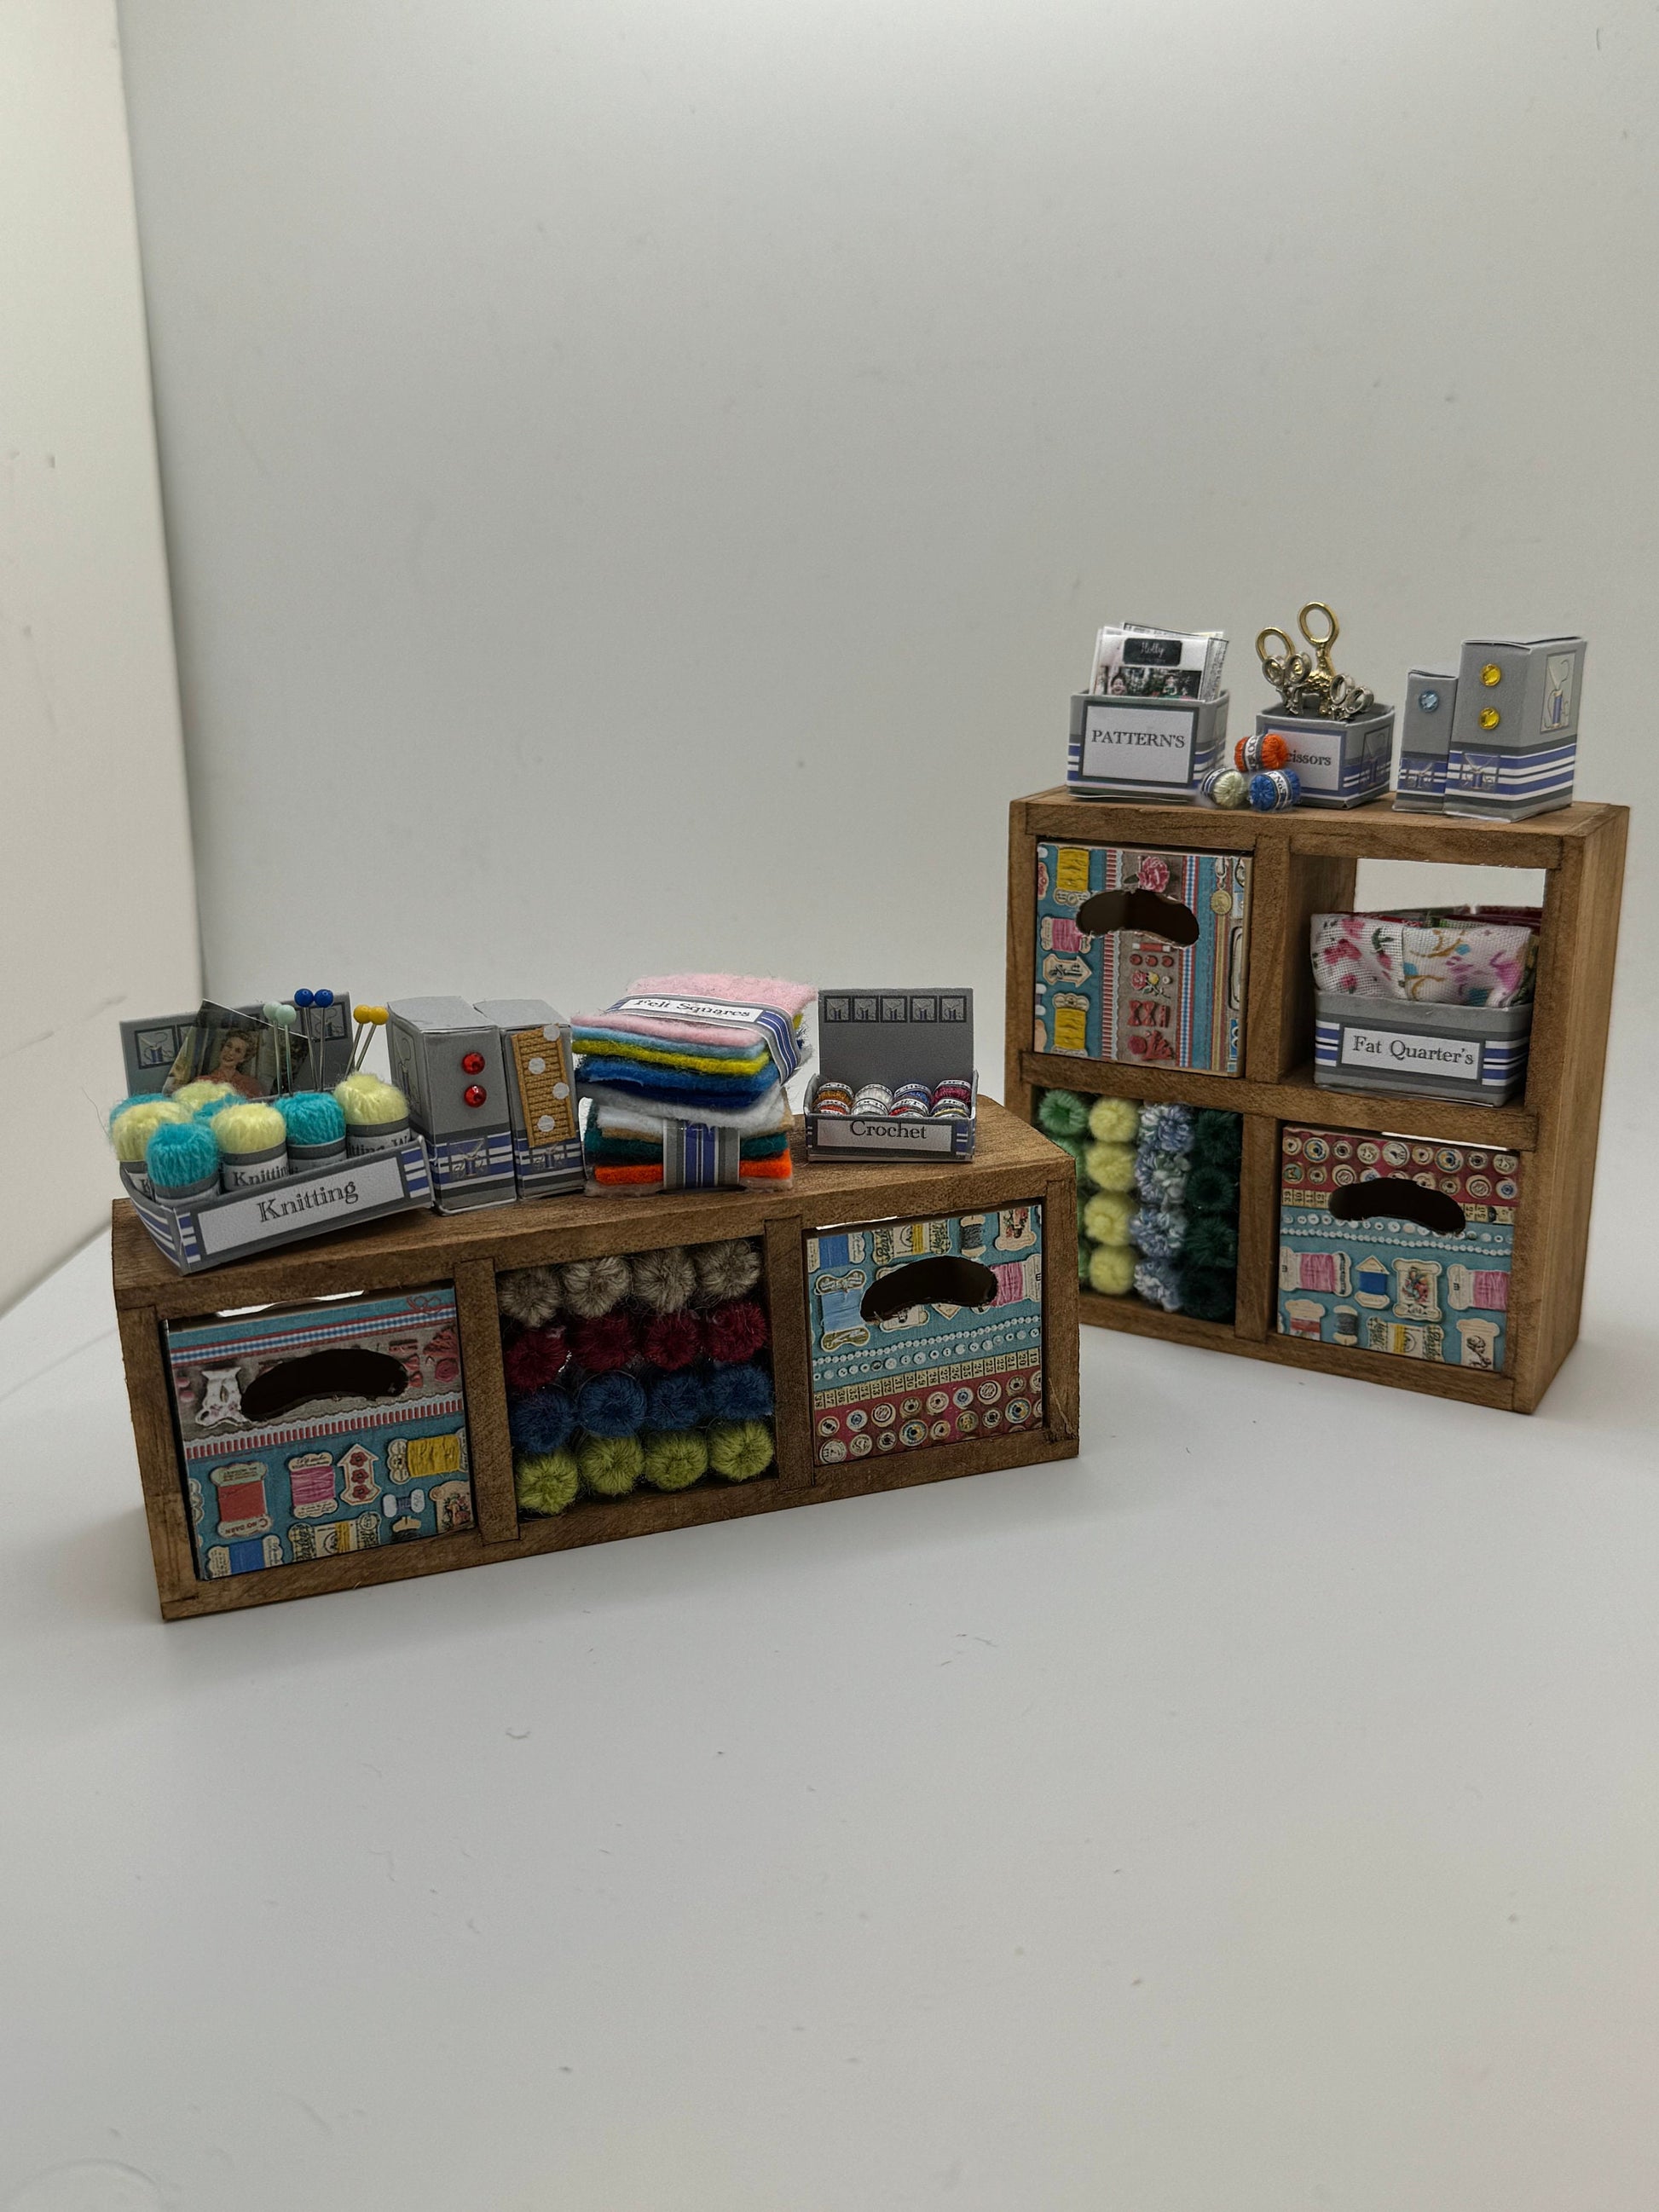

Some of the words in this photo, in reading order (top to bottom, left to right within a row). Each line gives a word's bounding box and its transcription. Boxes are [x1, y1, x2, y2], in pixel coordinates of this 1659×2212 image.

[1091, 730, 1185, 748] PATTERN'S
[1286, 749, 1332, 766] cissors
[634, 999, 671, 1008] Felt
[676, 1002, 751, 1017] Squares
[1352, 1035, 1382, 1054] Fat
[1390, 1039, 1474, 1066] Quarter's
[849, 1119, 927, 1140] Crochet
[232, 1163, 291, 1187] Knittin
[257, 1181, 359, 1222] Knitting
